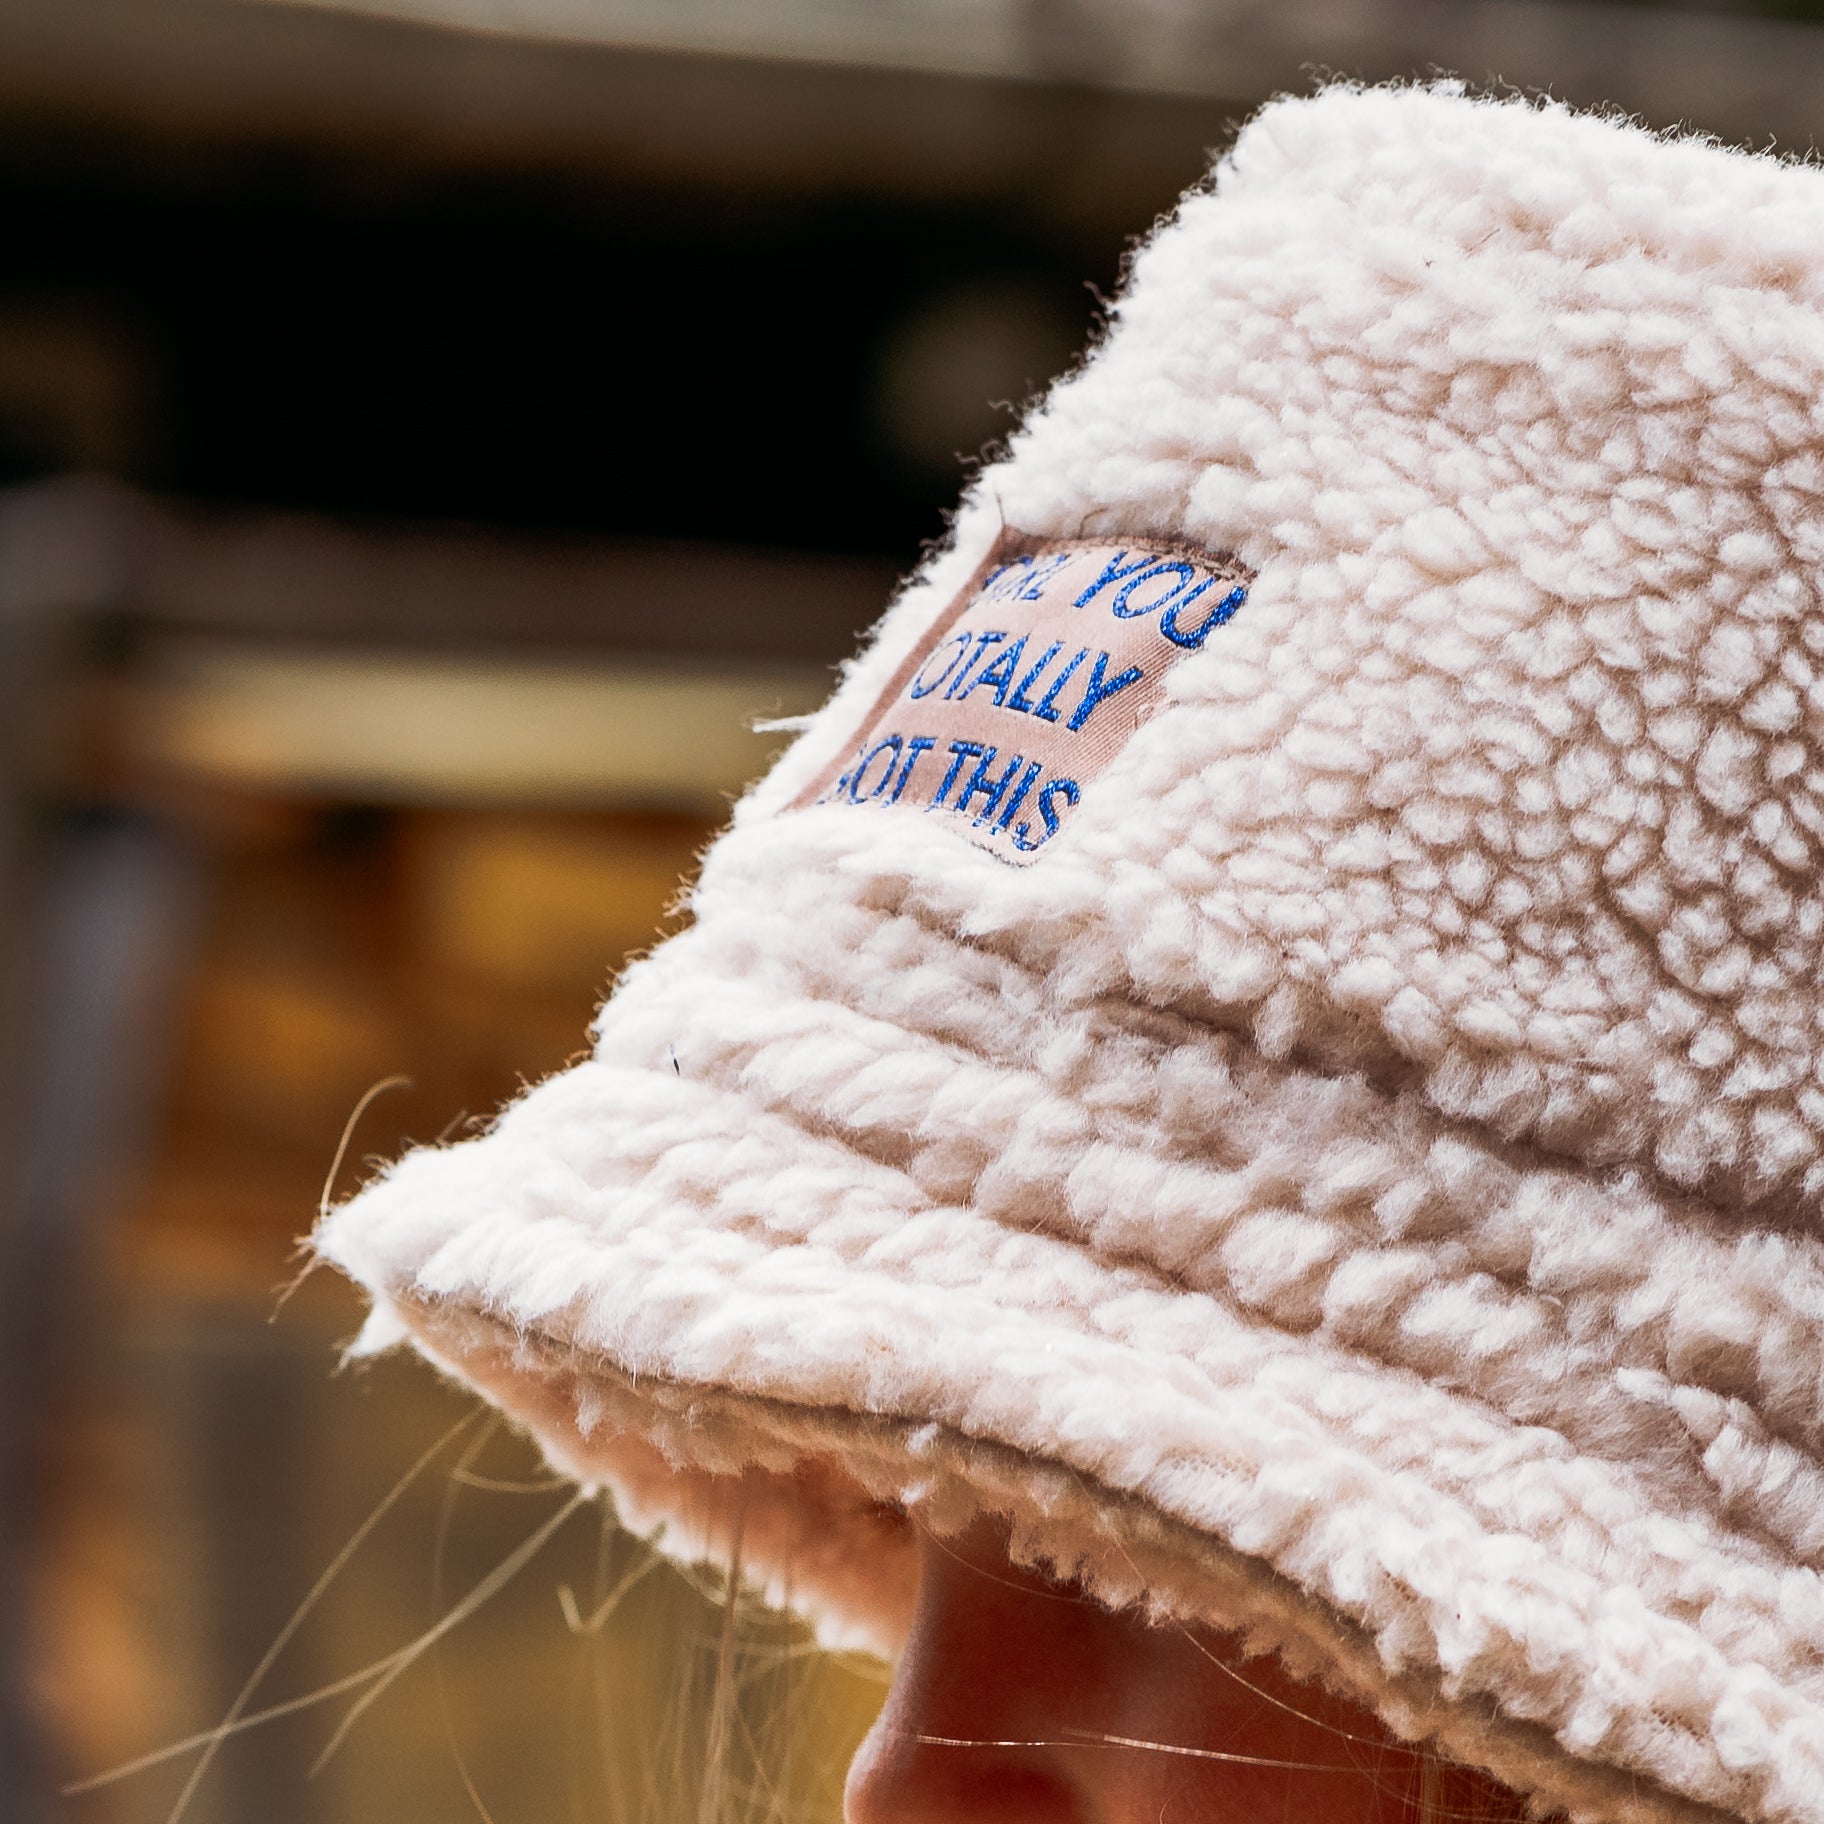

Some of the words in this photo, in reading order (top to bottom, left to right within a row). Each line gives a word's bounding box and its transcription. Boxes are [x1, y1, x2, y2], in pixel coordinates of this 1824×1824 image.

[1072, 551, 1247, 648] YOU
[909, 631, 1143, 732] OTALLY
[817, 733, 938, 808] OT
[924, 739, 1081, 851] THIS
